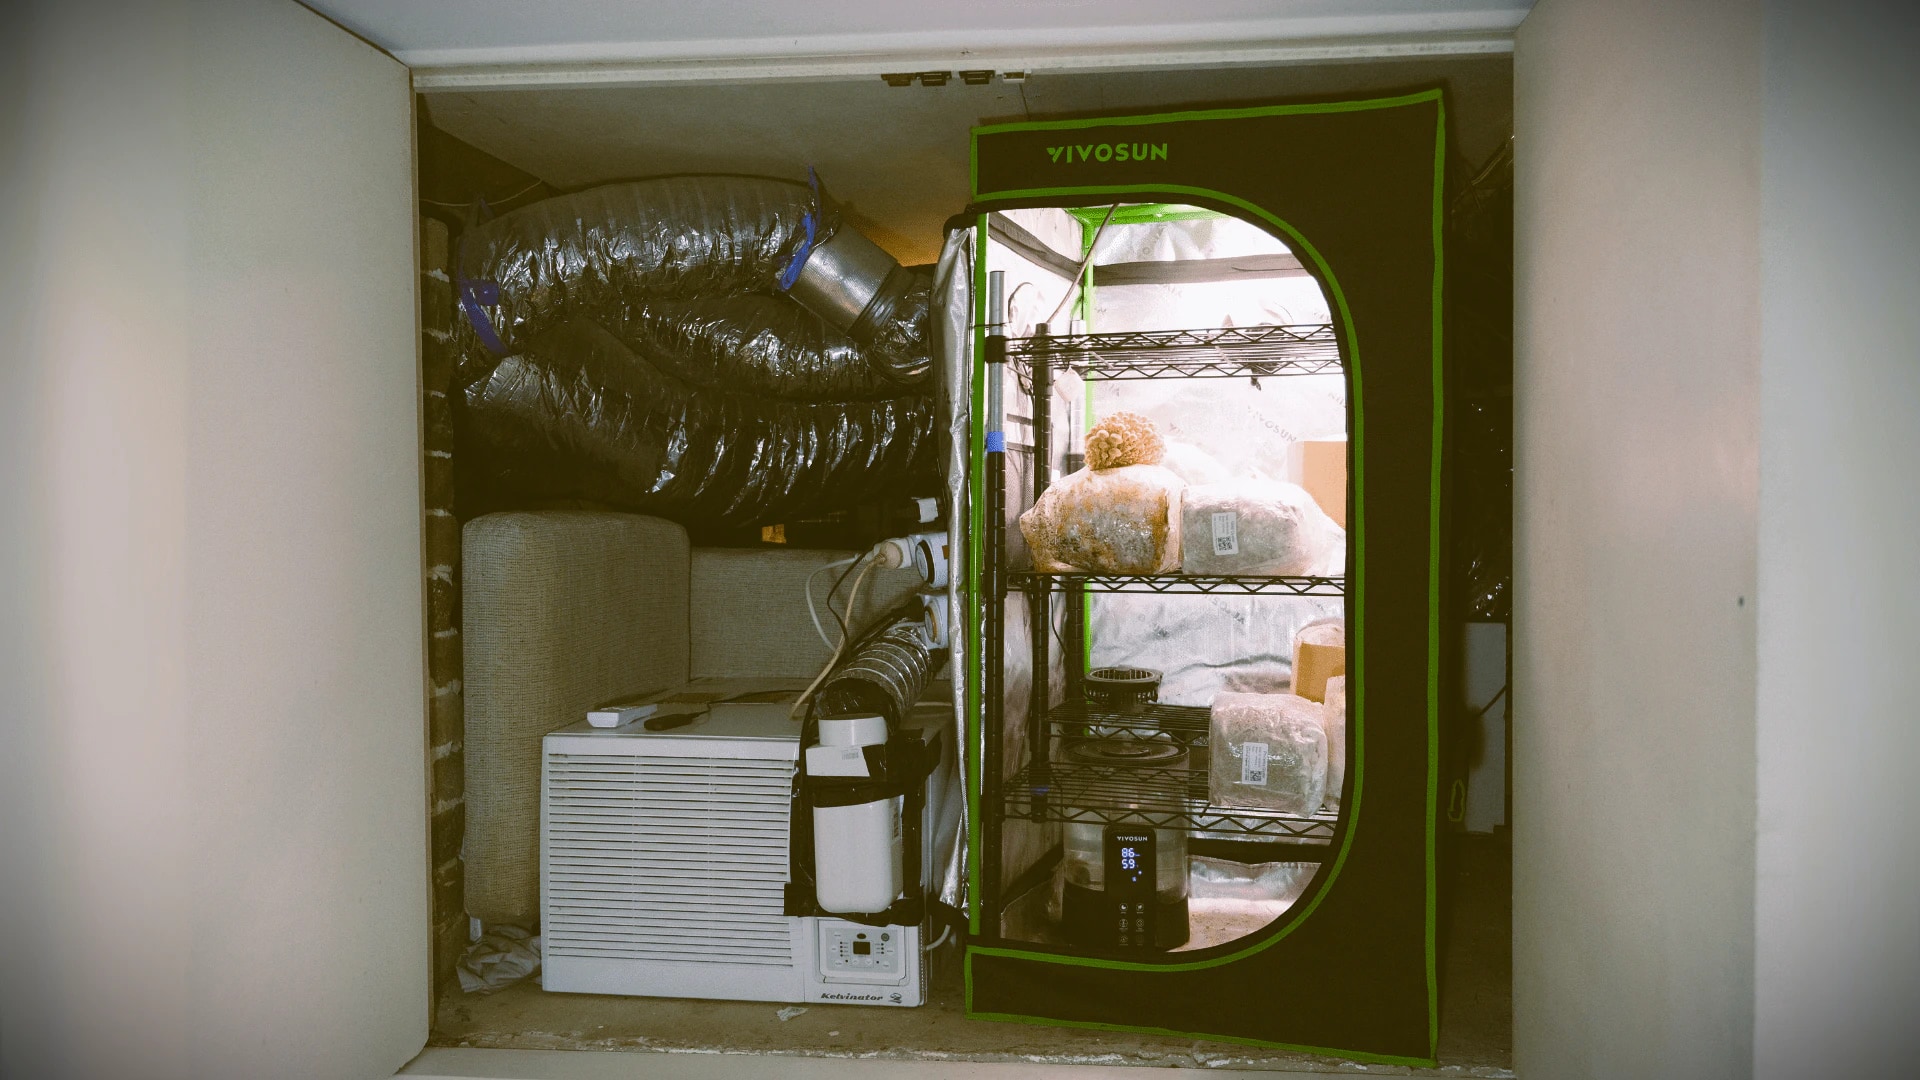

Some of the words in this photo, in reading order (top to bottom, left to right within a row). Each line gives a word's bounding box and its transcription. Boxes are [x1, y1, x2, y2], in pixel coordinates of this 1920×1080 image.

[1046, 143, 1168, 163] VIVOSUN
[1121, 847, 1135, 858] 86
[1121, 858, 1136, 869] 59
[821, 992, 883, 1001] Kelvinator
